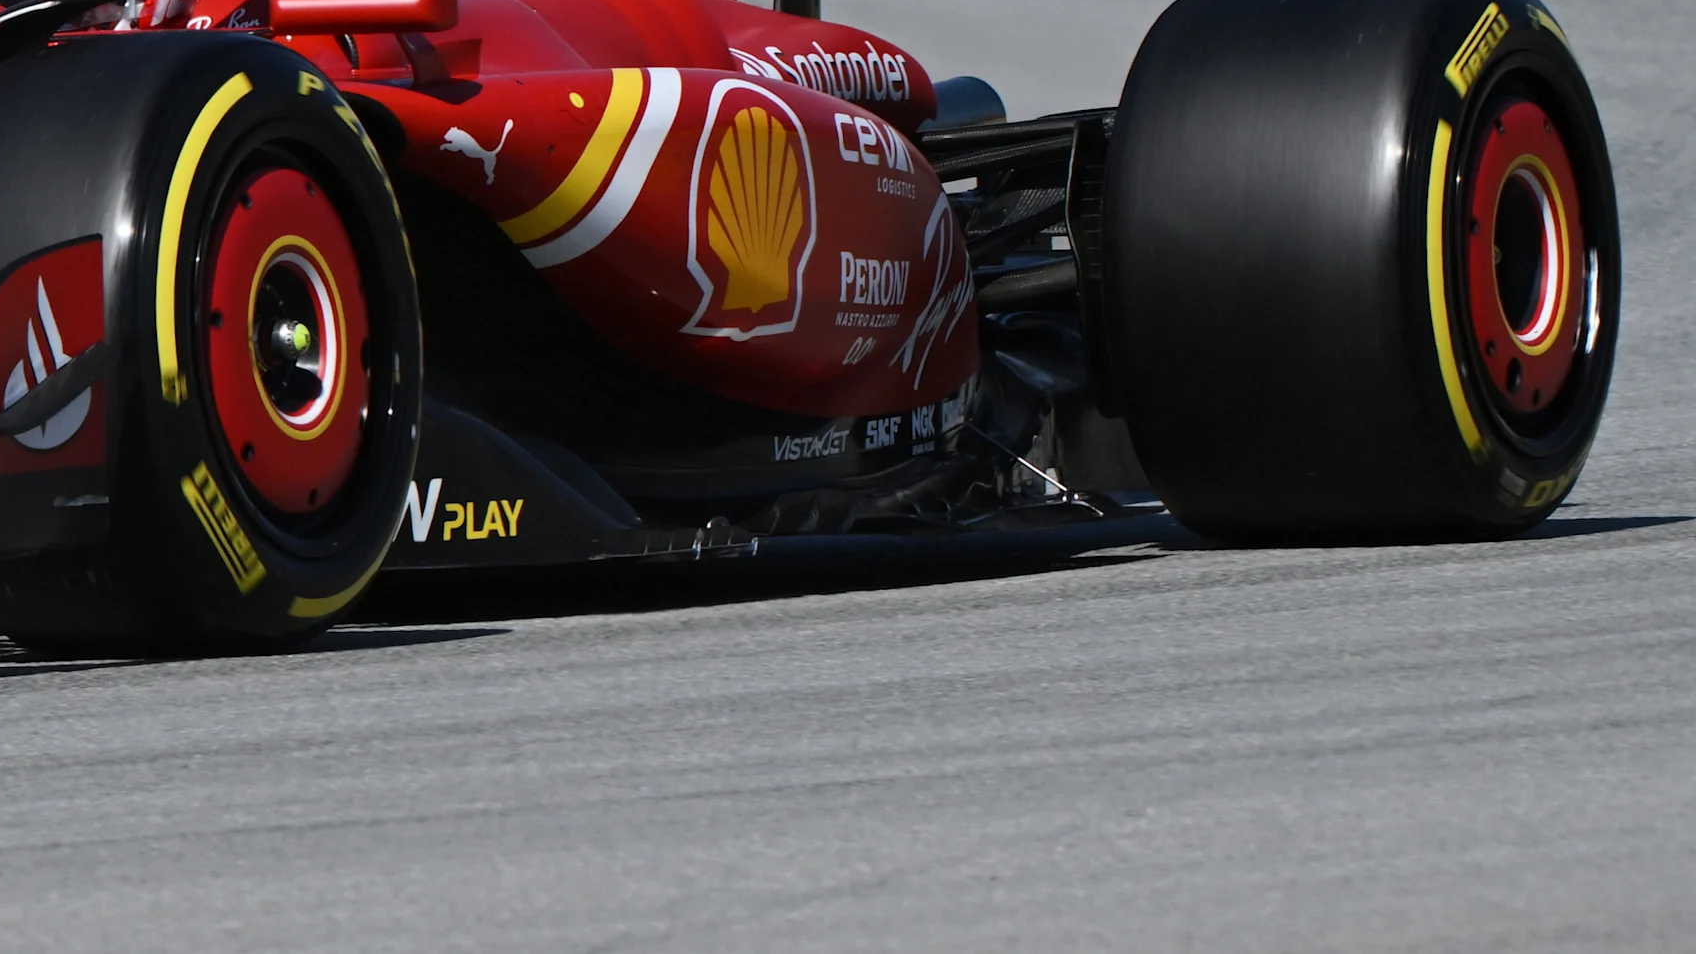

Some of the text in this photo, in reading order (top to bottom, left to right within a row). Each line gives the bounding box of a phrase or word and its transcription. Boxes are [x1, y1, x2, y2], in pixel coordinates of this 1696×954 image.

[764, 40, 911, 102] Santander
[1444, 1, 1510, 100] PIRELLI
[834, 112, 916, 175] CEVA
[877, 176, 916, 200] LOGISTICS
[839, 250, 911, 307] PERONI
[835, 311, 869, 327] NASTRO
[864, 415, 902, 451] SKF
[911, 402, 936, 441] NGK
[179, 459, 267, 596] PIRELLI
[443, 498, 525, 542] PLAY
